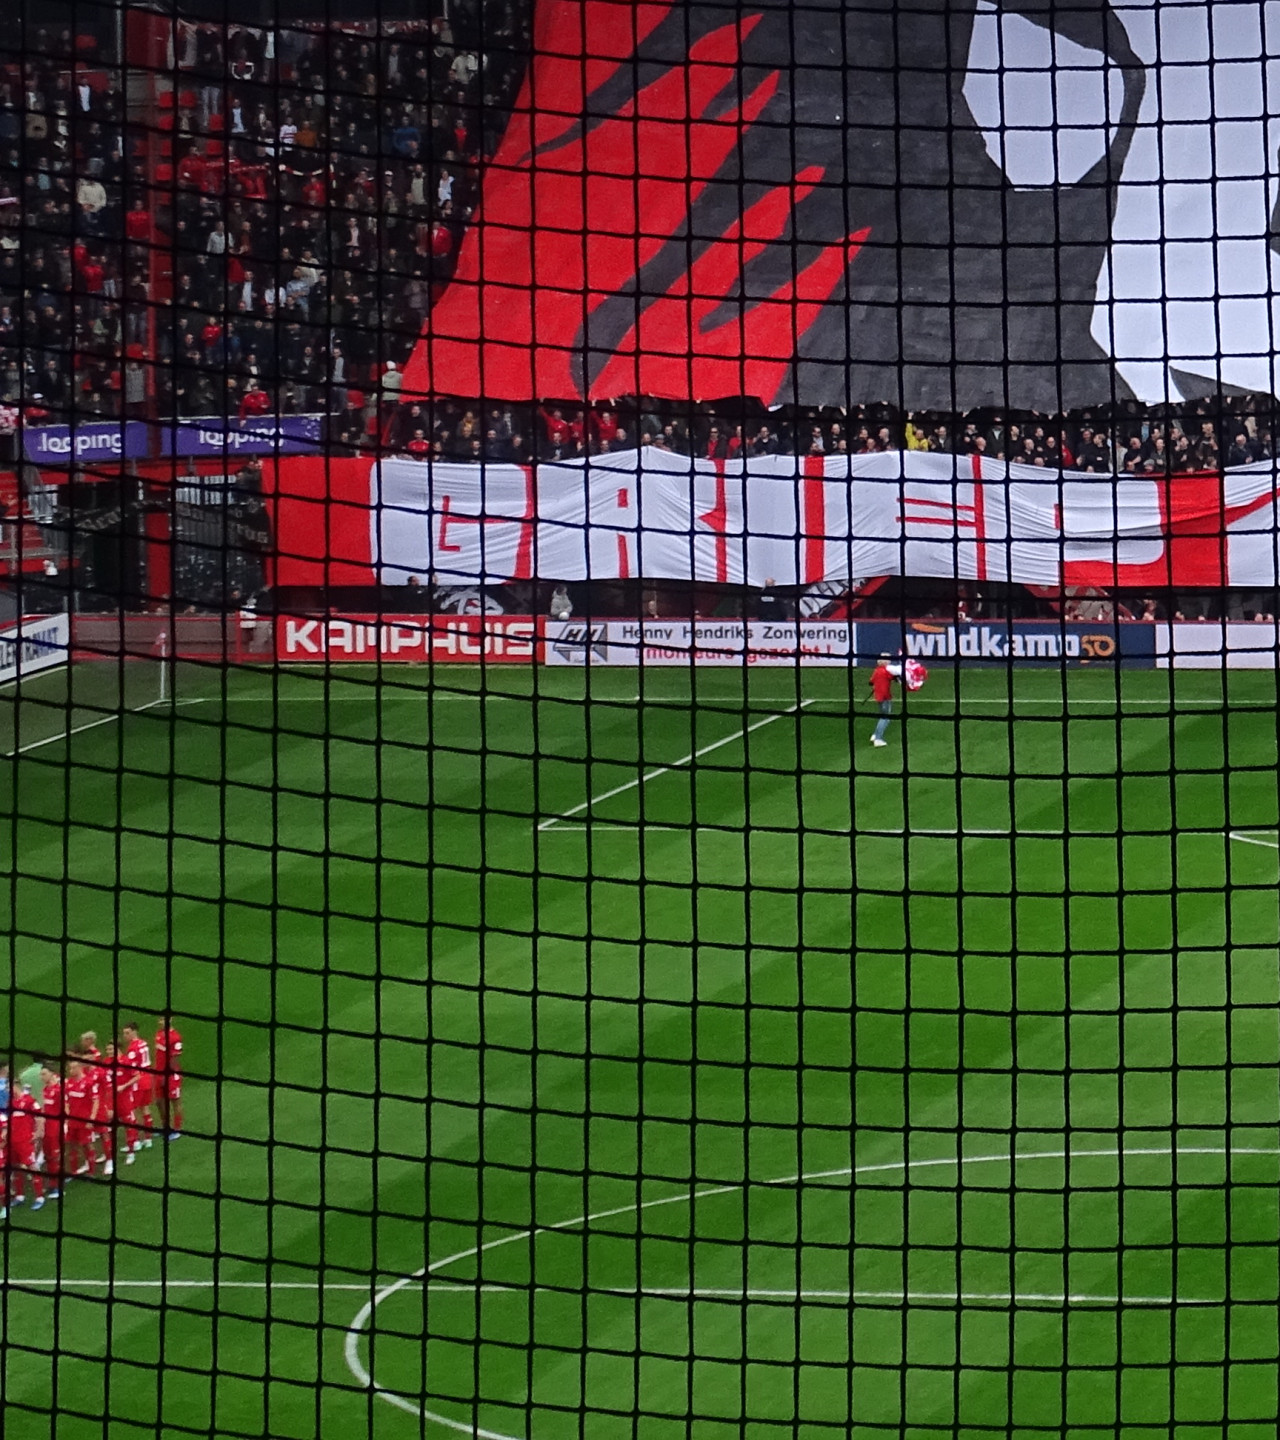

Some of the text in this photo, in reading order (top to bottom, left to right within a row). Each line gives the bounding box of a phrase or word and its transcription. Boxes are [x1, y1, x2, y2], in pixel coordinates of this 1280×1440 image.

[286, 620, 535, 655] KAMPHUIS
[622, 626, 848, 642] Henny Hendriks Zonwering
